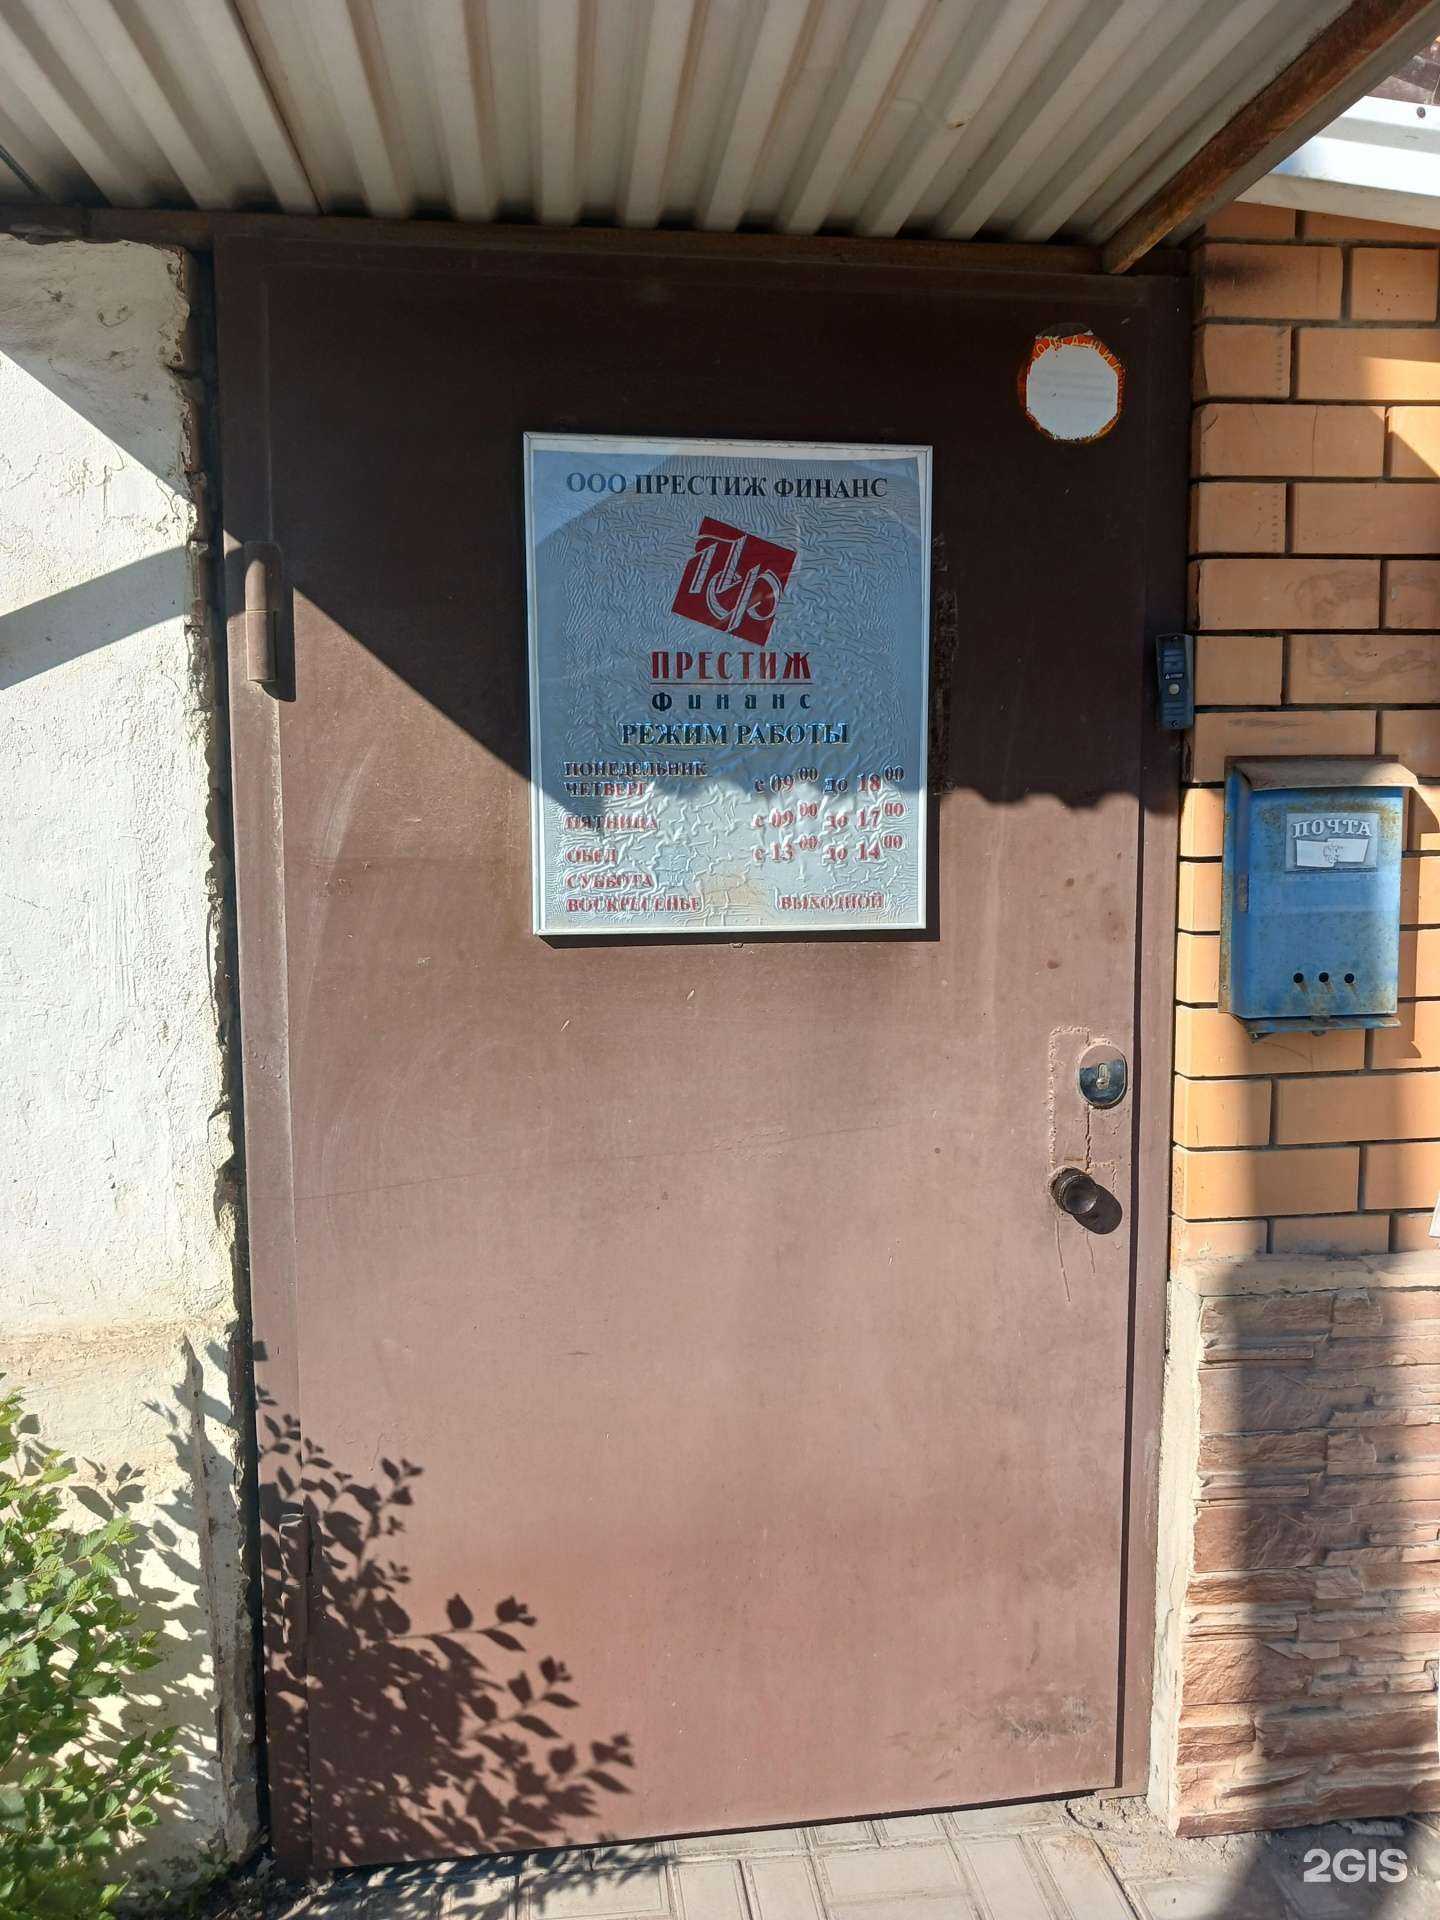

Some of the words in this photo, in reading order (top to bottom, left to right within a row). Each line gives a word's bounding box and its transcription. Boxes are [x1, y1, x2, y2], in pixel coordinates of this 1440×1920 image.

[566, 472, 627, 494] ООО
[635, 474, 767, 496] ПРЕСТИЖ
[774, 476, 888, 498] ФИНАНС
[651, 651, 812, 679] ПРЕСТИЖ
[619, 722, 727, 746] РЕЖИМ
[737, 722, 849, 745] РАБОТЫ
[564, 761, 706, 777] ПОНЕДЕЛЬНИК
[564, 781, 649, 796] ЧЕТВЕРГ
[824, 777, 848, 794] до
[564, 815, 658, 832] ПЯТНИЦА
[826, 812, 848, 829] до
[1293, 819, 1373, 838] ПОЧТА
[826, 845, 848, 861] до
[566, 874, 652, 888] СУББОТА
[567, 897, 701, 912] ВОСКРЕСЕНЬЕ
[780, 893, 884, 910] ВЫХОДНОЙ
